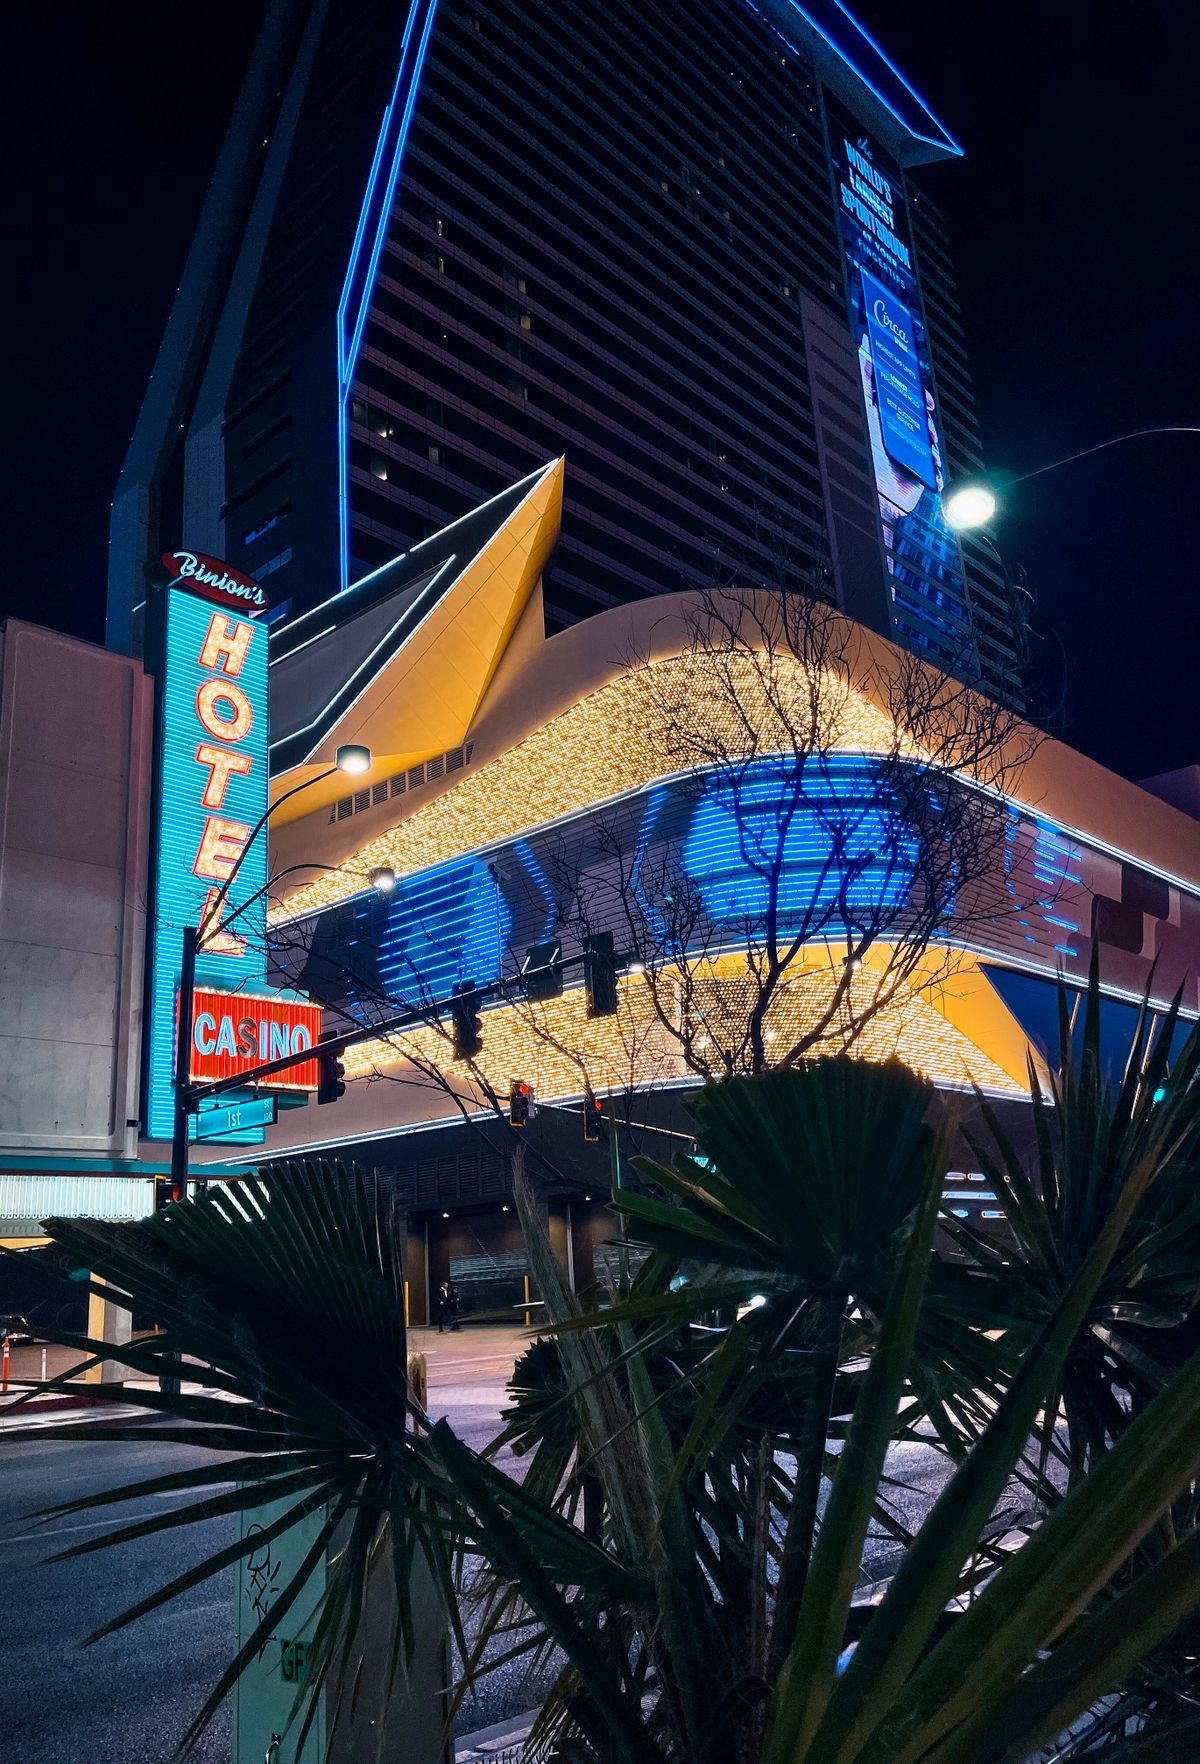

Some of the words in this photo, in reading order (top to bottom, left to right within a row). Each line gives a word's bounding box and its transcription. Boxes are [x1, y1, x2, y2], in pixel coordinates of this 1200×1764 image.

[844, 138, 893, 205] WORLD'S
[856, 138, 874, 160] the
[848, 167, 895, 230] LARGEST
[840, 183, 911, 270] SPORTSBOOK
[858, 237, 906, 290] FINGERTIPS
[873, 299, 909, 344] Circa
[173, 551, 266, 605] Binion's
[193, 612, 255, 957] HOTEL
[194, 1012, 311, 1063] CASINO
[227, 1108, 241, 1128] 1st
